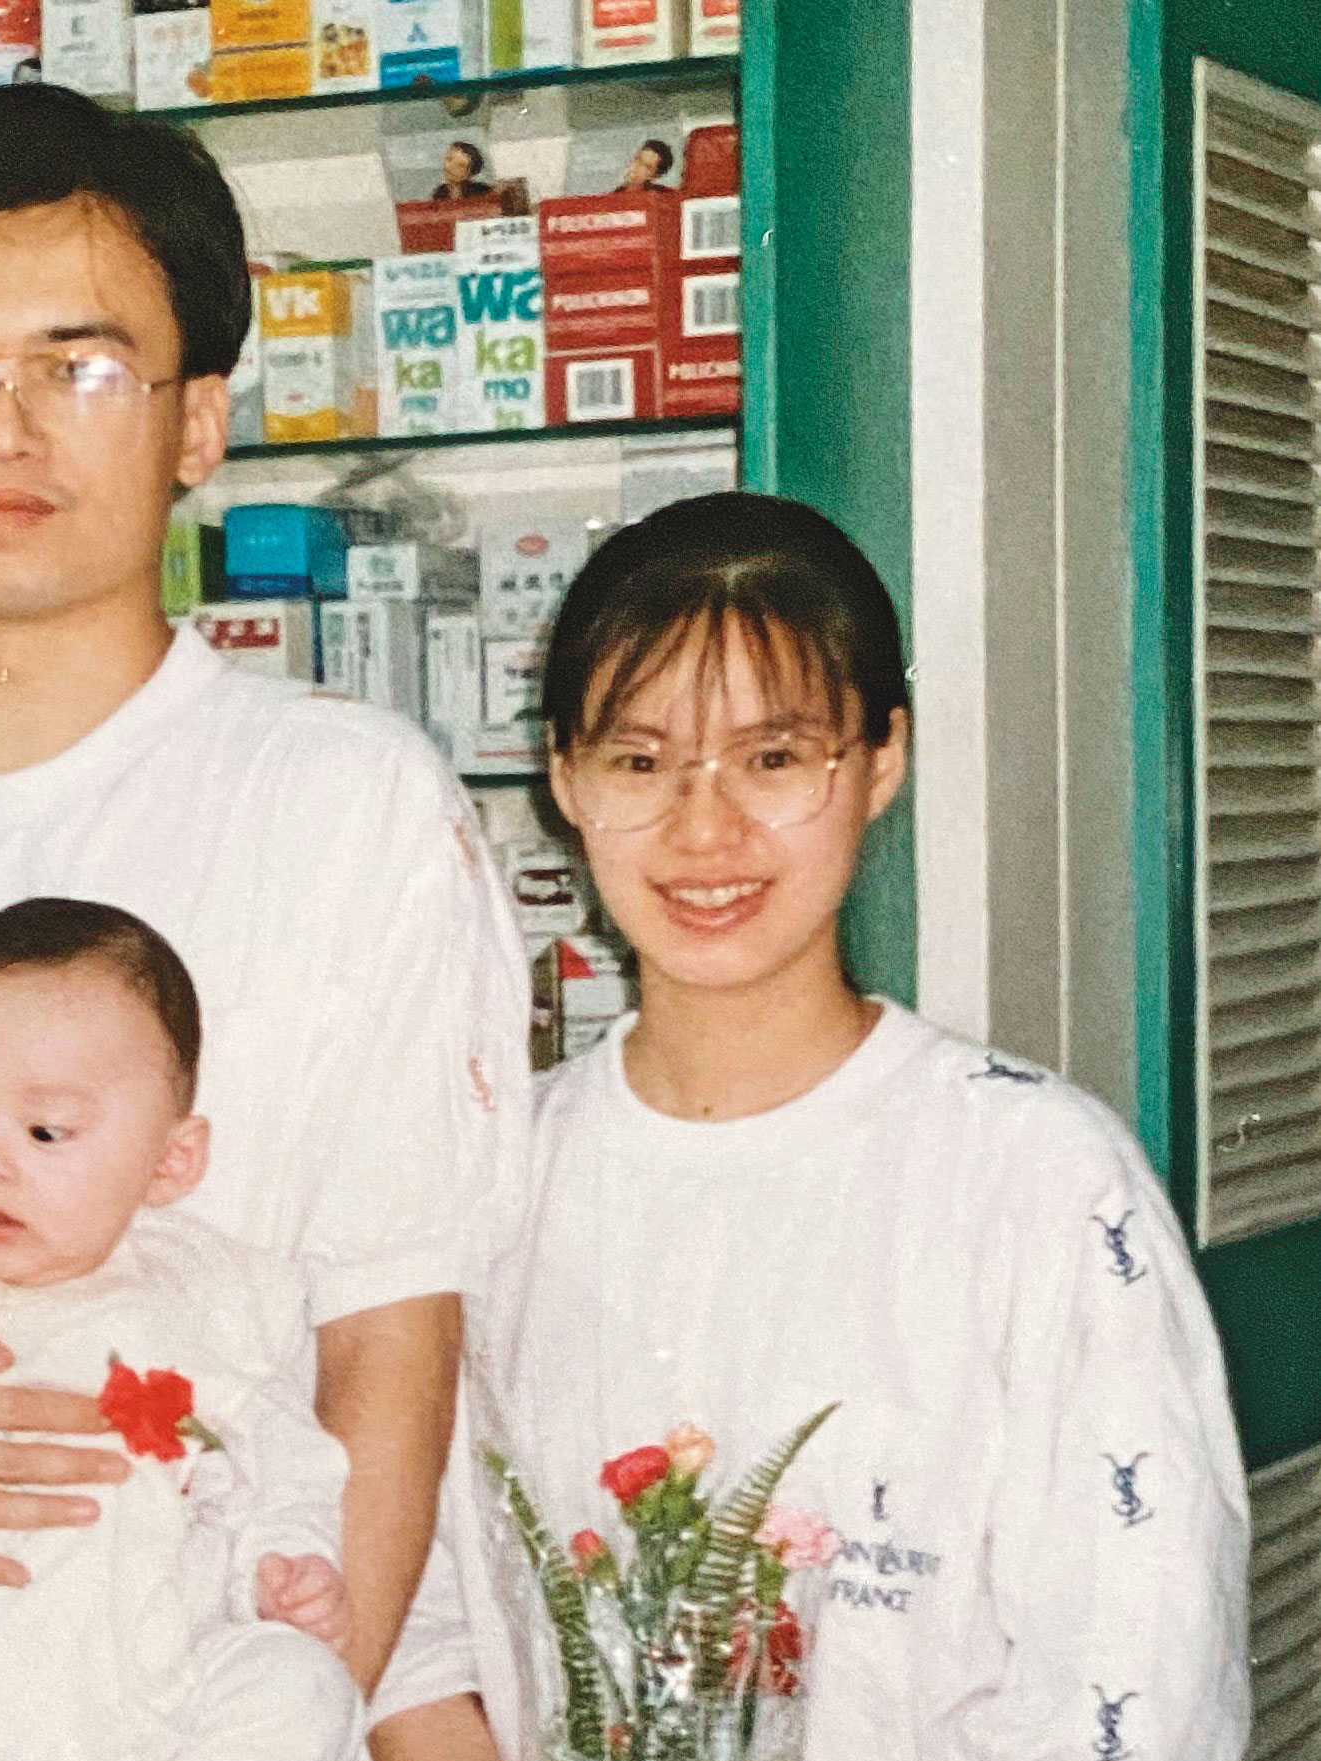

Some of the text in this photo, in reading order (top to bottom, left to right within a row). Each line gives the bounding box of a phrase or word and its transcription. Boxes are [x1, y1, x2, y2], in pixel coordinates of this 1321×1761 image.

[381, 306, 457, 350] wa
[394, 354, 442, 391] ka
[476, 328, 536, 377] ka
[484, 378, 531, 401] mo
